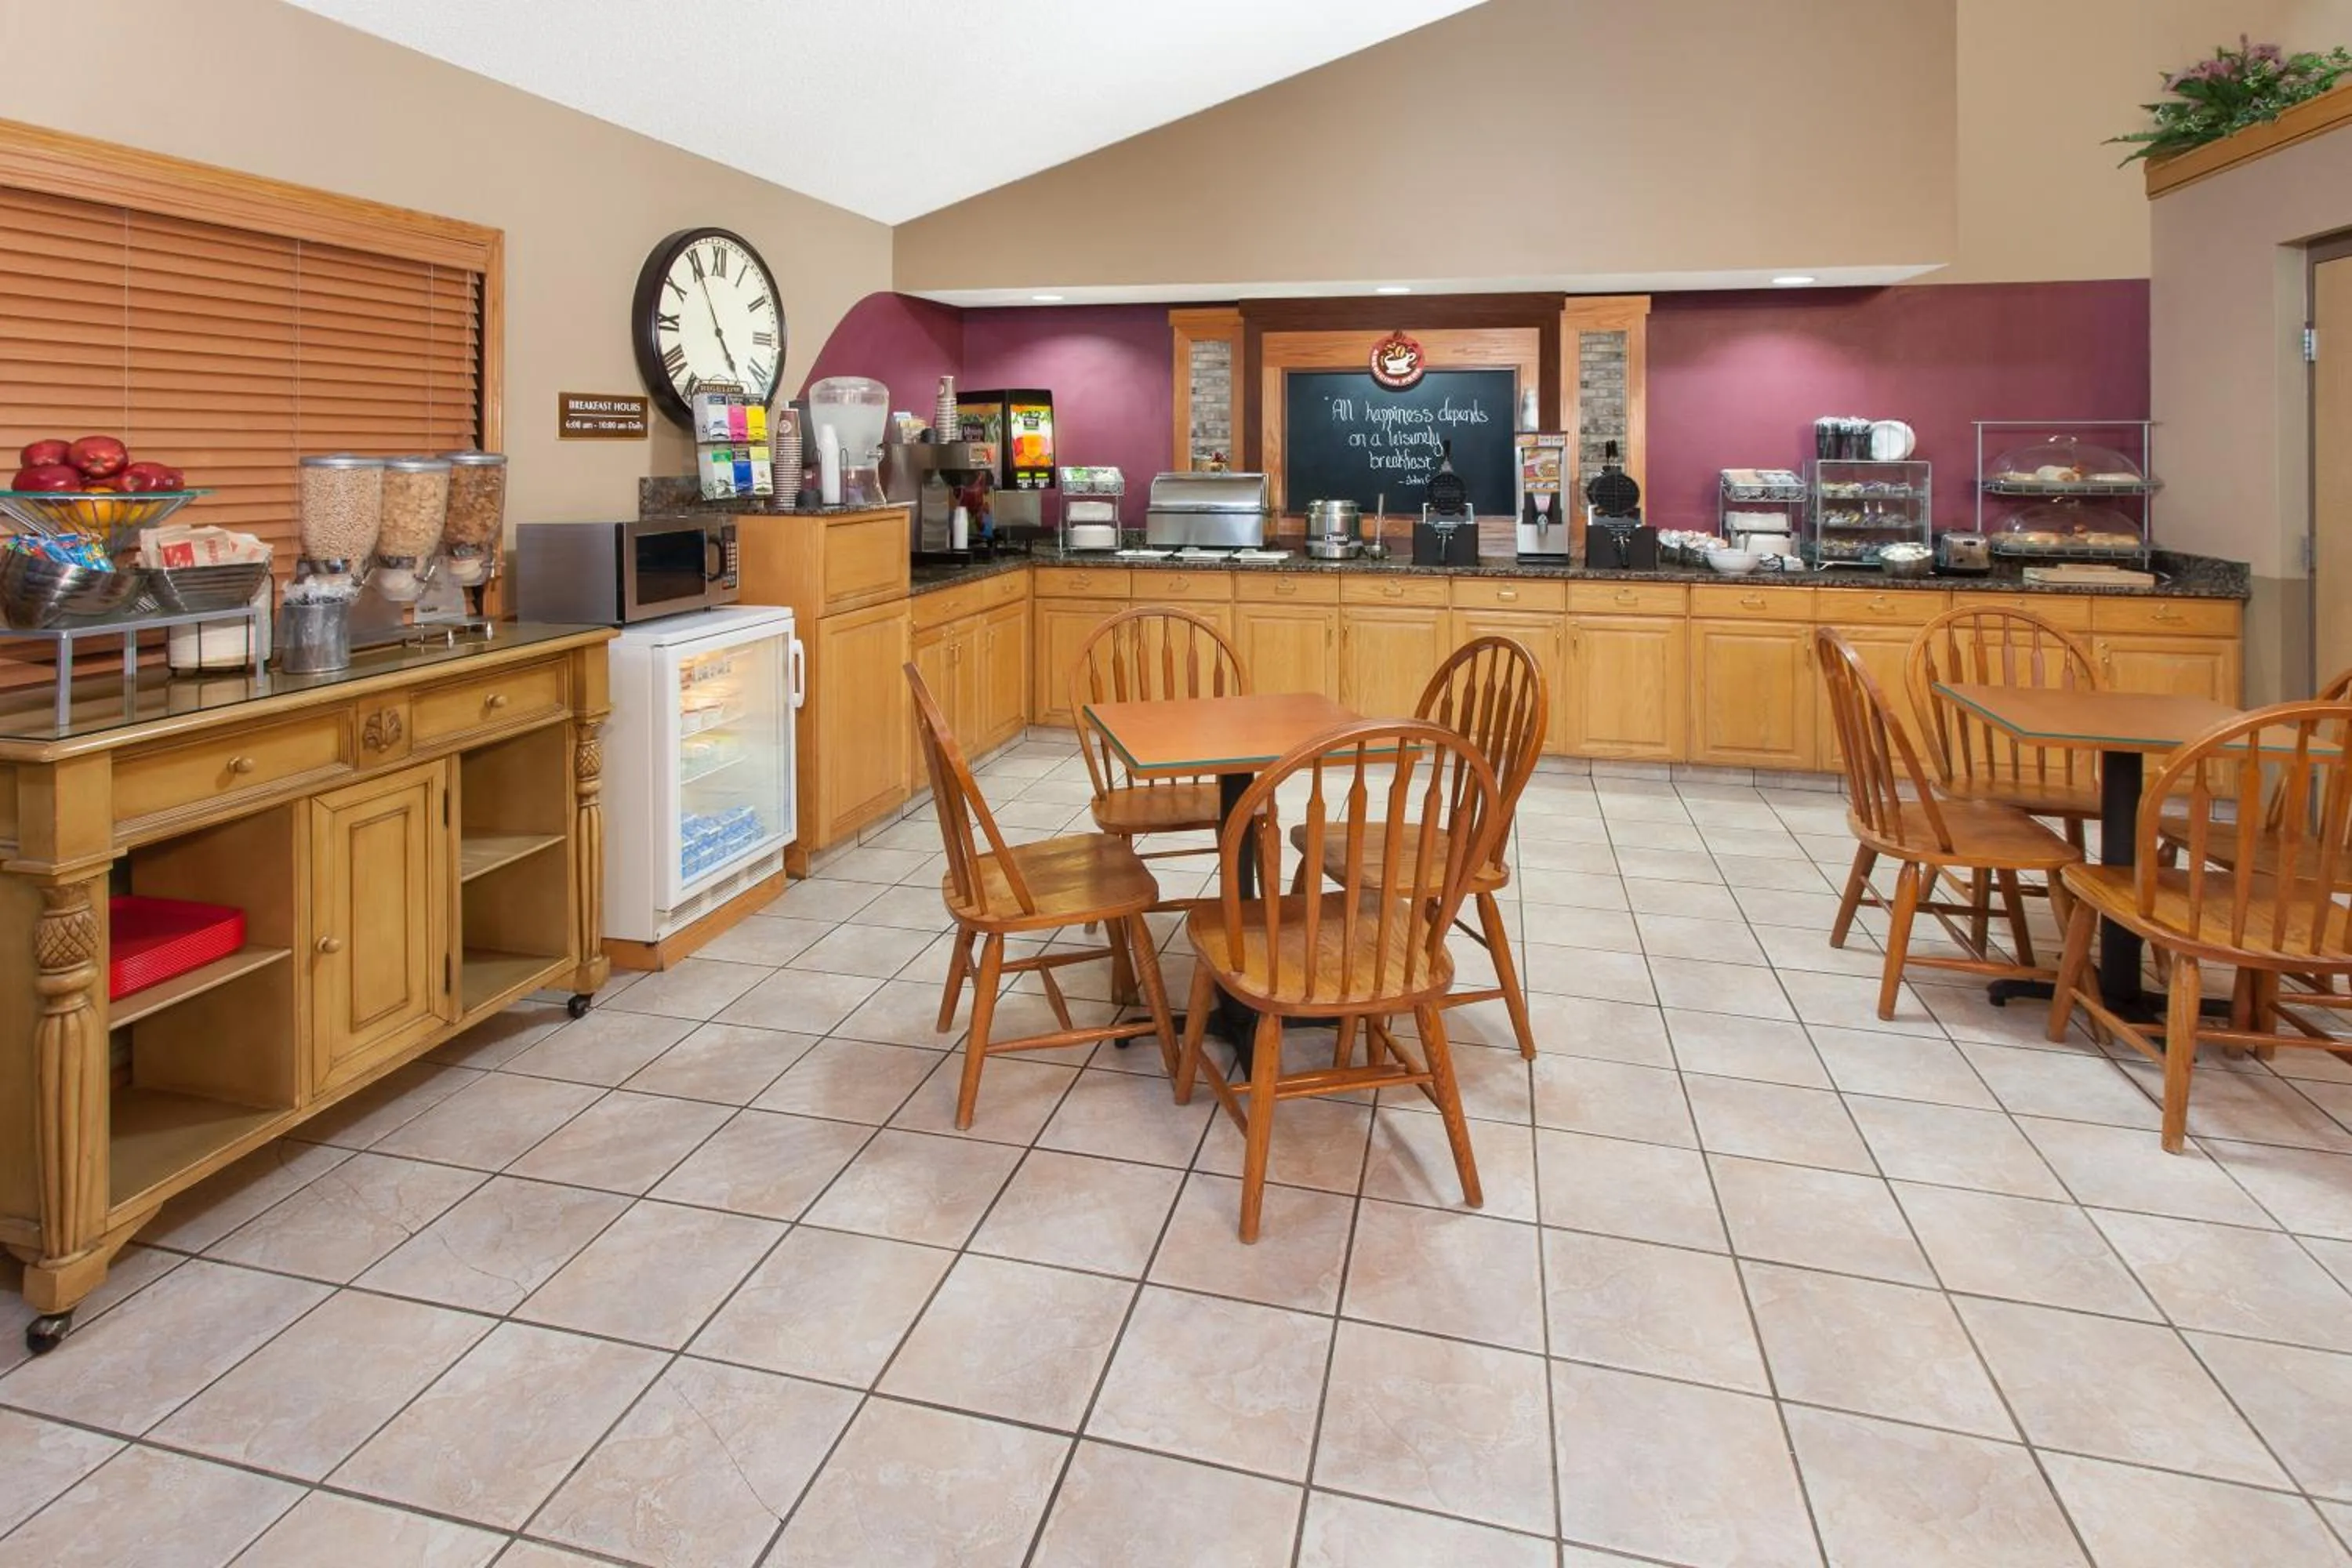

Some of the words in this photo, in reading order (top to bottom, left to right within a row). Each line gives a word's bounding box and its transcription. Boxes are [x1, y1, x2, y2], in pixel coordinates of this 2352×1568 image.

[712, 246, 727, 278] XII
[735, 264, 747, 288] I
[748, 296, 766, 313] II
[659, 314, 680, 330] IX
[753, 332, 772, 346] III
[664, 343, 688, 379] VIII
[568, 400, 612, 410] BREAKFAST
[614, 402, 641, 412] HOURS
[1365, 401, 1434, 430] happiness
[1437, 394, 1489, 426] depends
[1348, 433, 1367, 447] on
[1371, 434, 1382, 447] a
